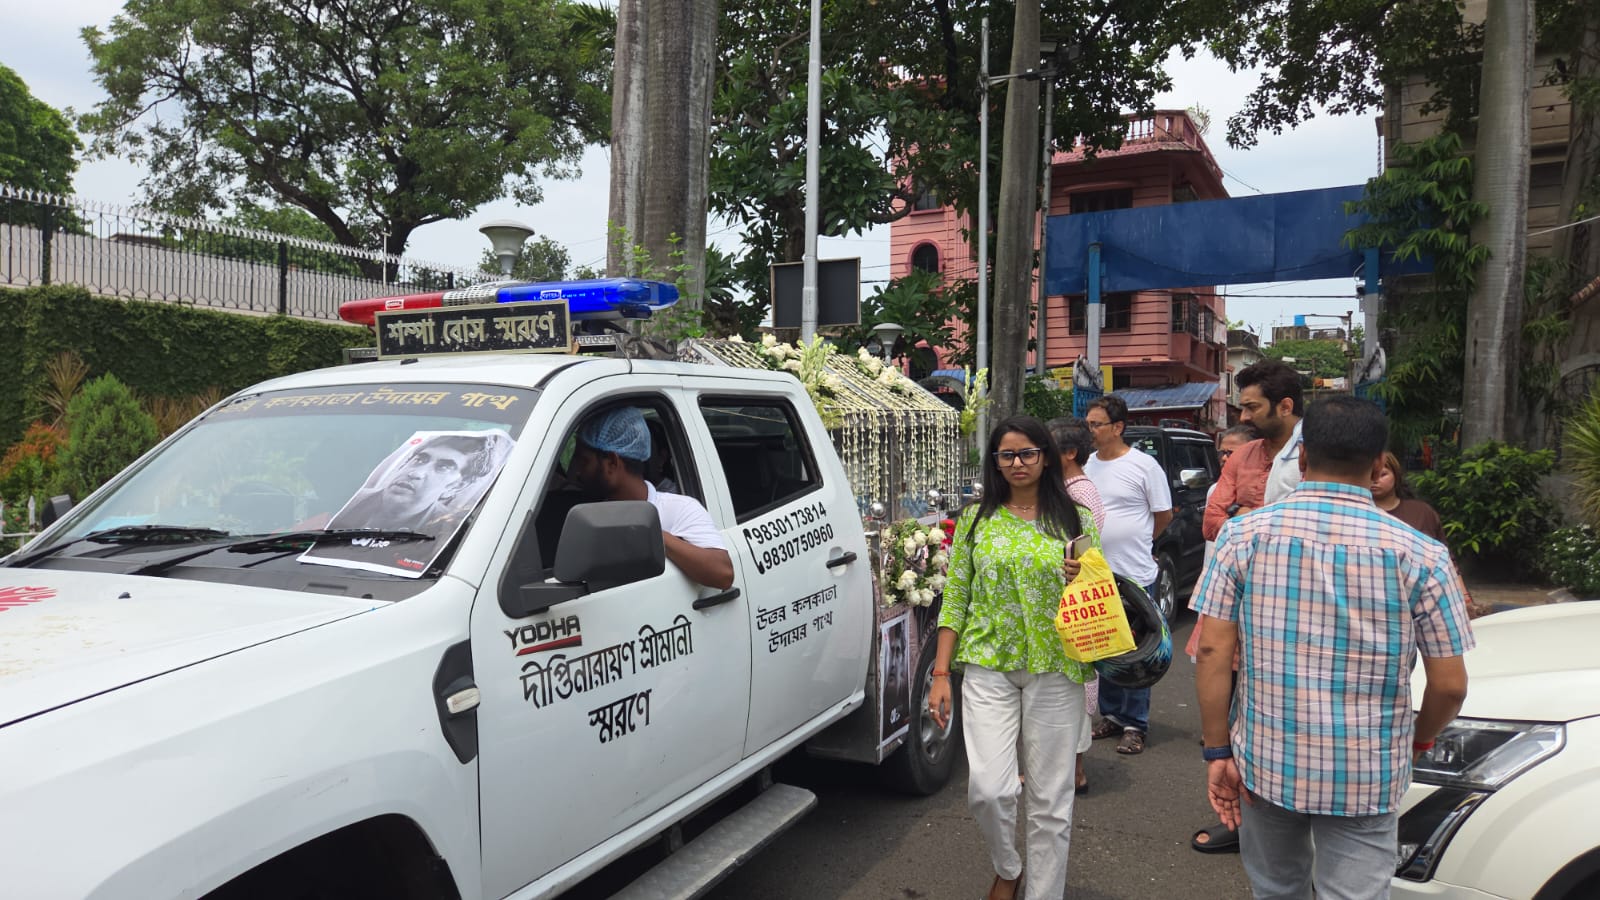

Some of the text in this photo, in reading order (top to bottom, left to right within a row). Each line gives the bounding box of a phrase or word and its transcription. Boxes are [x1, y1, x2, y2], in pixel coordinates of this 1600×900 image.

[387, 311, 556, 345] শম্পা বোস স্মরণে
[460, 392, 519, 411] পথে
[752, 501, 827, 545] 9830173814
[763, 523, 834, 570] 9830750960
[791, 584, 837, 615] কলকাতা
[1080, 584, 1115, 602] KALI
[812, 611, 833, 632] পথে
[1062, 602, 1106, 623] STORE
[503, 615, 581, 650] YODHA
[638, 614, 694, 669] শ্রীমানী
[588, 688, 652, 744] স্মরণে
